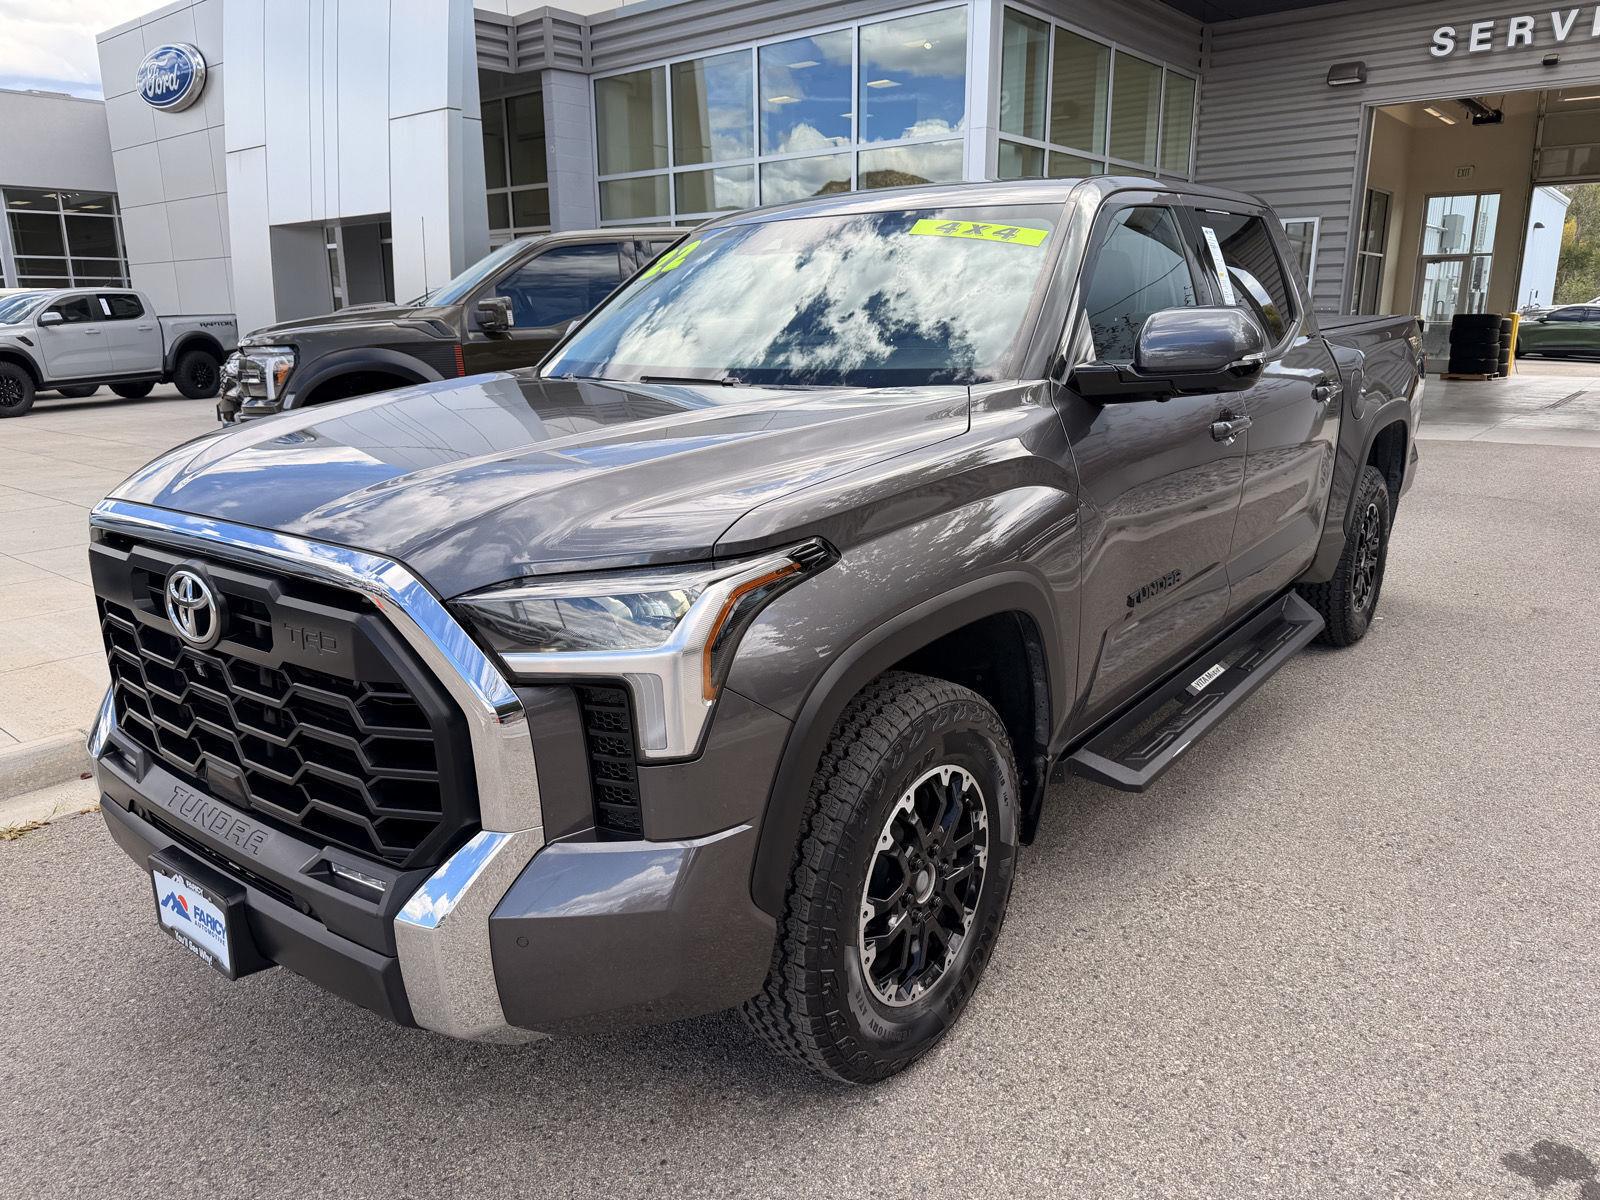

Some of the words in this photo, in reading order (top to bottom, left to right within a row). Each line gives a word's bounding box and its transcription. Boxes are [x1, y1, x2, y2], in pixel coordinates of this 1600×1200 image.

[144, 58, 180, 98] Ford
[1457, 168, 1471, 178] EXIT
[200, 320, 233, 328] RAPTOR
[1126, 569, 1181, 607] TUNDRA
[283, 623, 338, 656] TRD
[167, 785, 269, 856] TUNDRA
[194, 905, 226, 939] FARICY
[195, 921, 225, 946] AUTOMOTIVE
